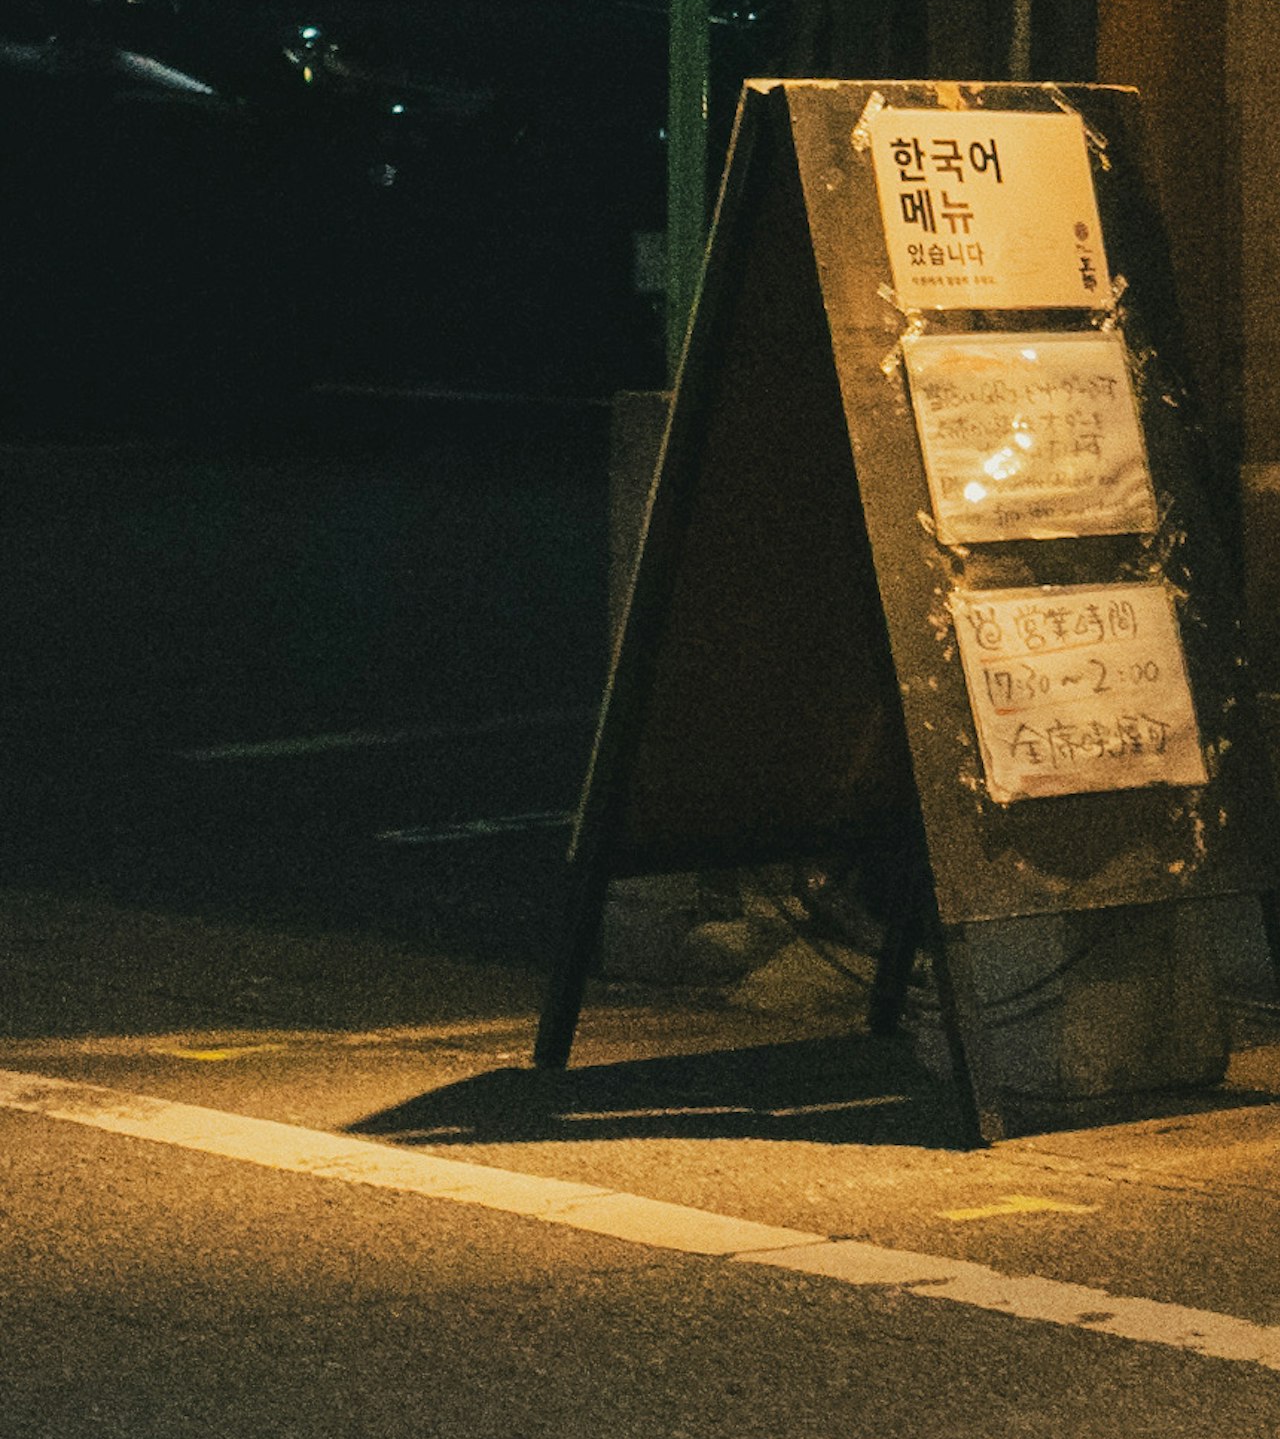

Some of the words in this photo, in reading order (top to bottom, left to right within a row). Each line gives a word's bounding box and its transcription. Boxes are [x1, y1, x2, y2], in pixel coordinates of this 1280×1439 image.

[890, 137, 1004, 184] 한국어
[900, 189, 975, 235] 메뉴
[906, 241, 985, 267] 있습니다
